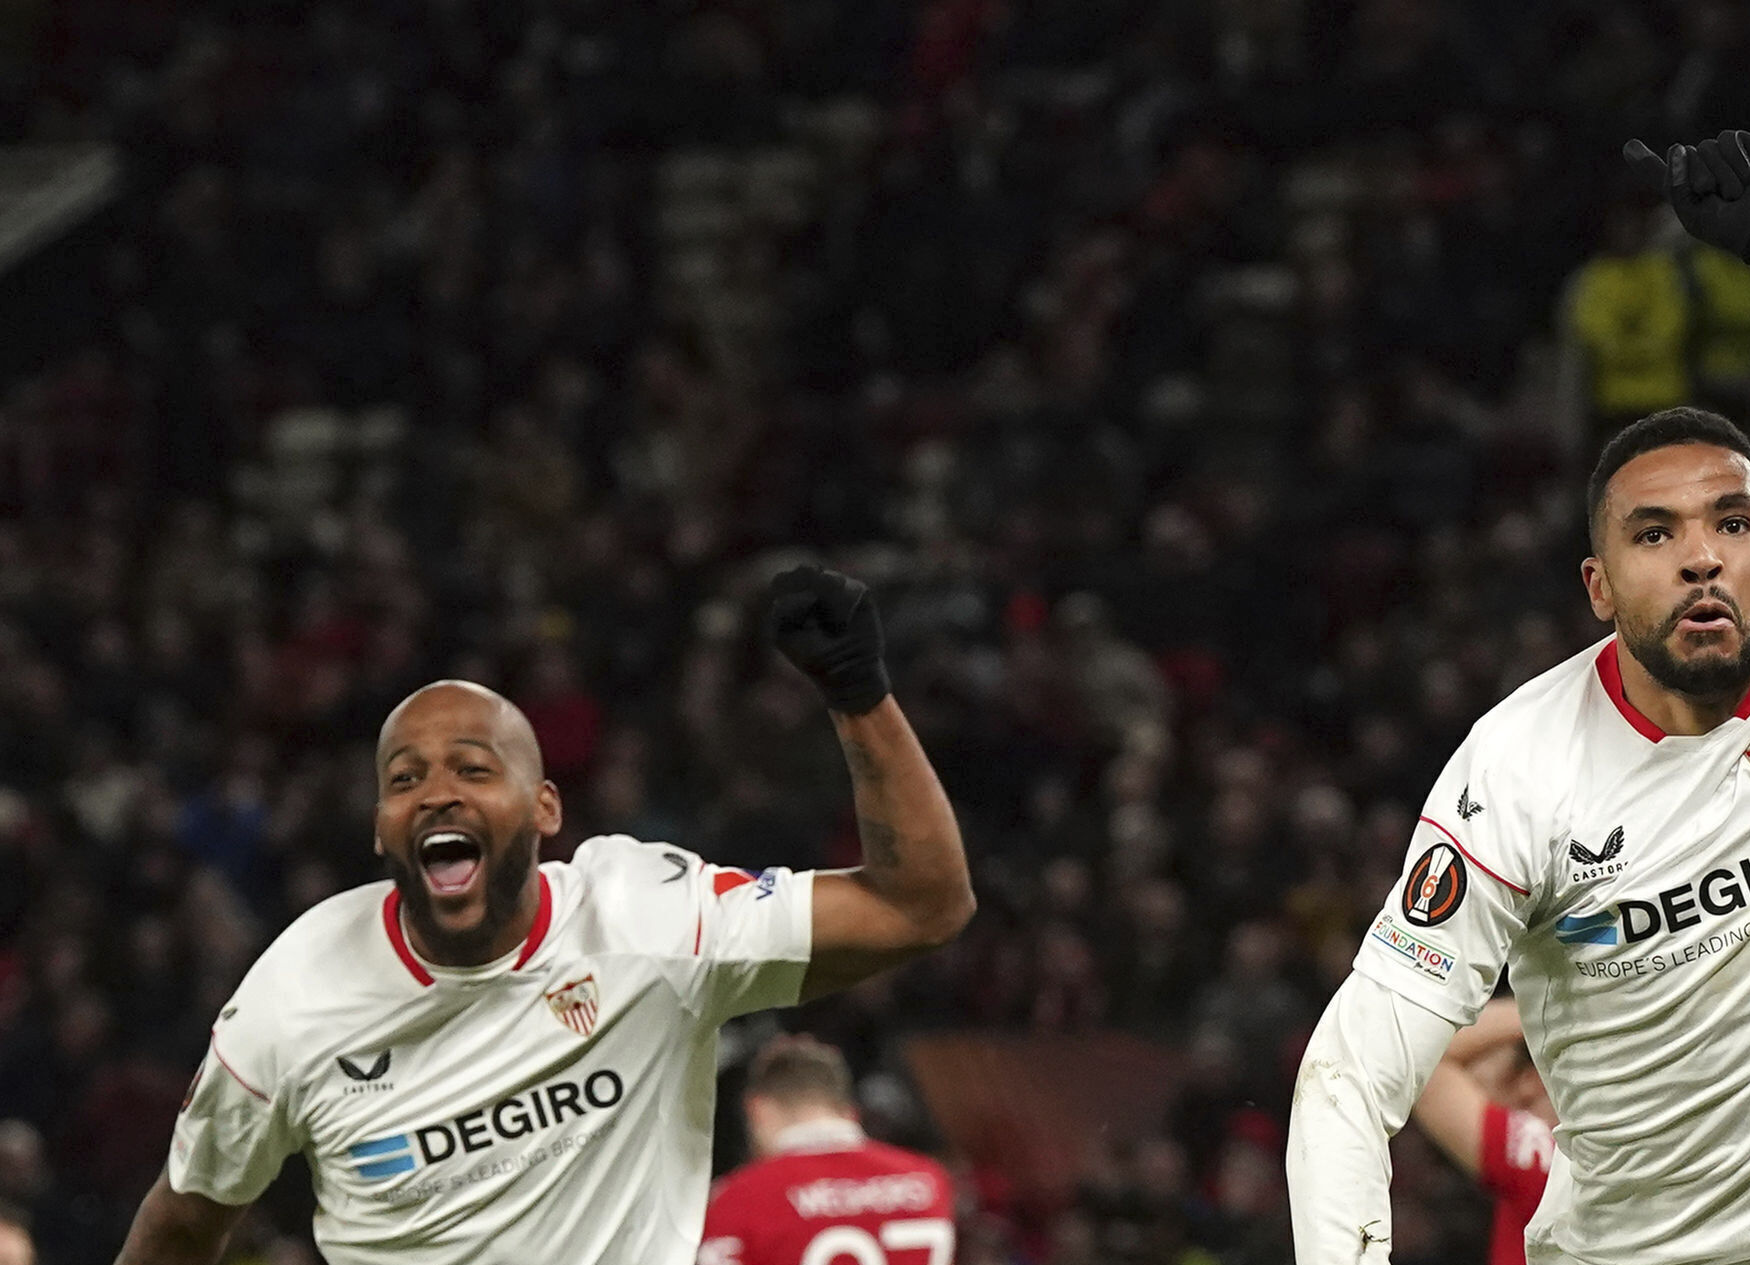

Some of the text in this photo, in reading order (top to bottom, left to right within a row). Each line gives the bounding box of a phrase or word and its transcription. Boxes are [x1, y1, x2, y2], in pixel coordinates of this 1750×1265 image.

[1374, 921, 1454, 973] FOUNDATION
[1576, 955, 1666, 978] EUROPE'S
[416, 1069, 624, 1165] DEGIRO
